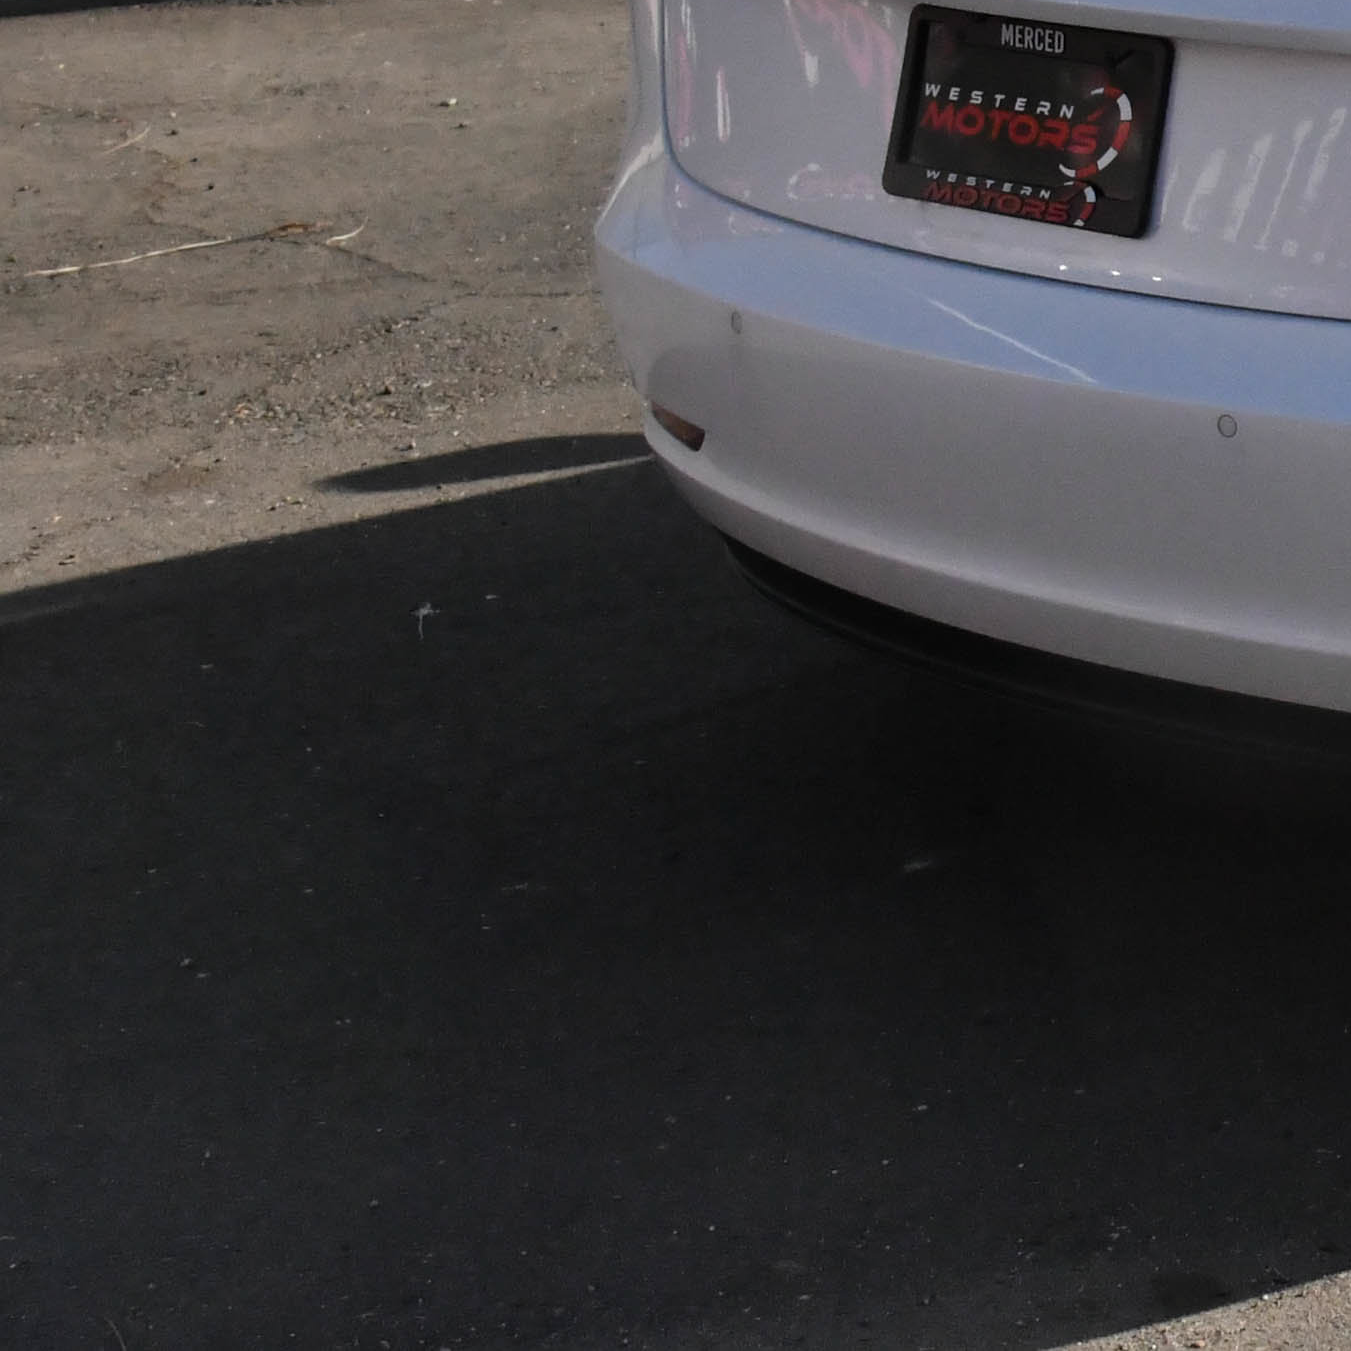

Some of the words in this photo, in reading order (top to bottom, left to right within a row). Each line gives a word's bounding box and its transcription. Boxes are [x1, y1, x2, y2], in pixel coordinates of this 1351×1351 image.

[1000, 23, 1065, 54] MERCED
[925, 82, 1075, 120] WESTERN
[920, 101, 1101, 155] MOTORS
[922, 182, 1072, 223] MOTORS
[925, 169, 1052, 200] WESTERN
